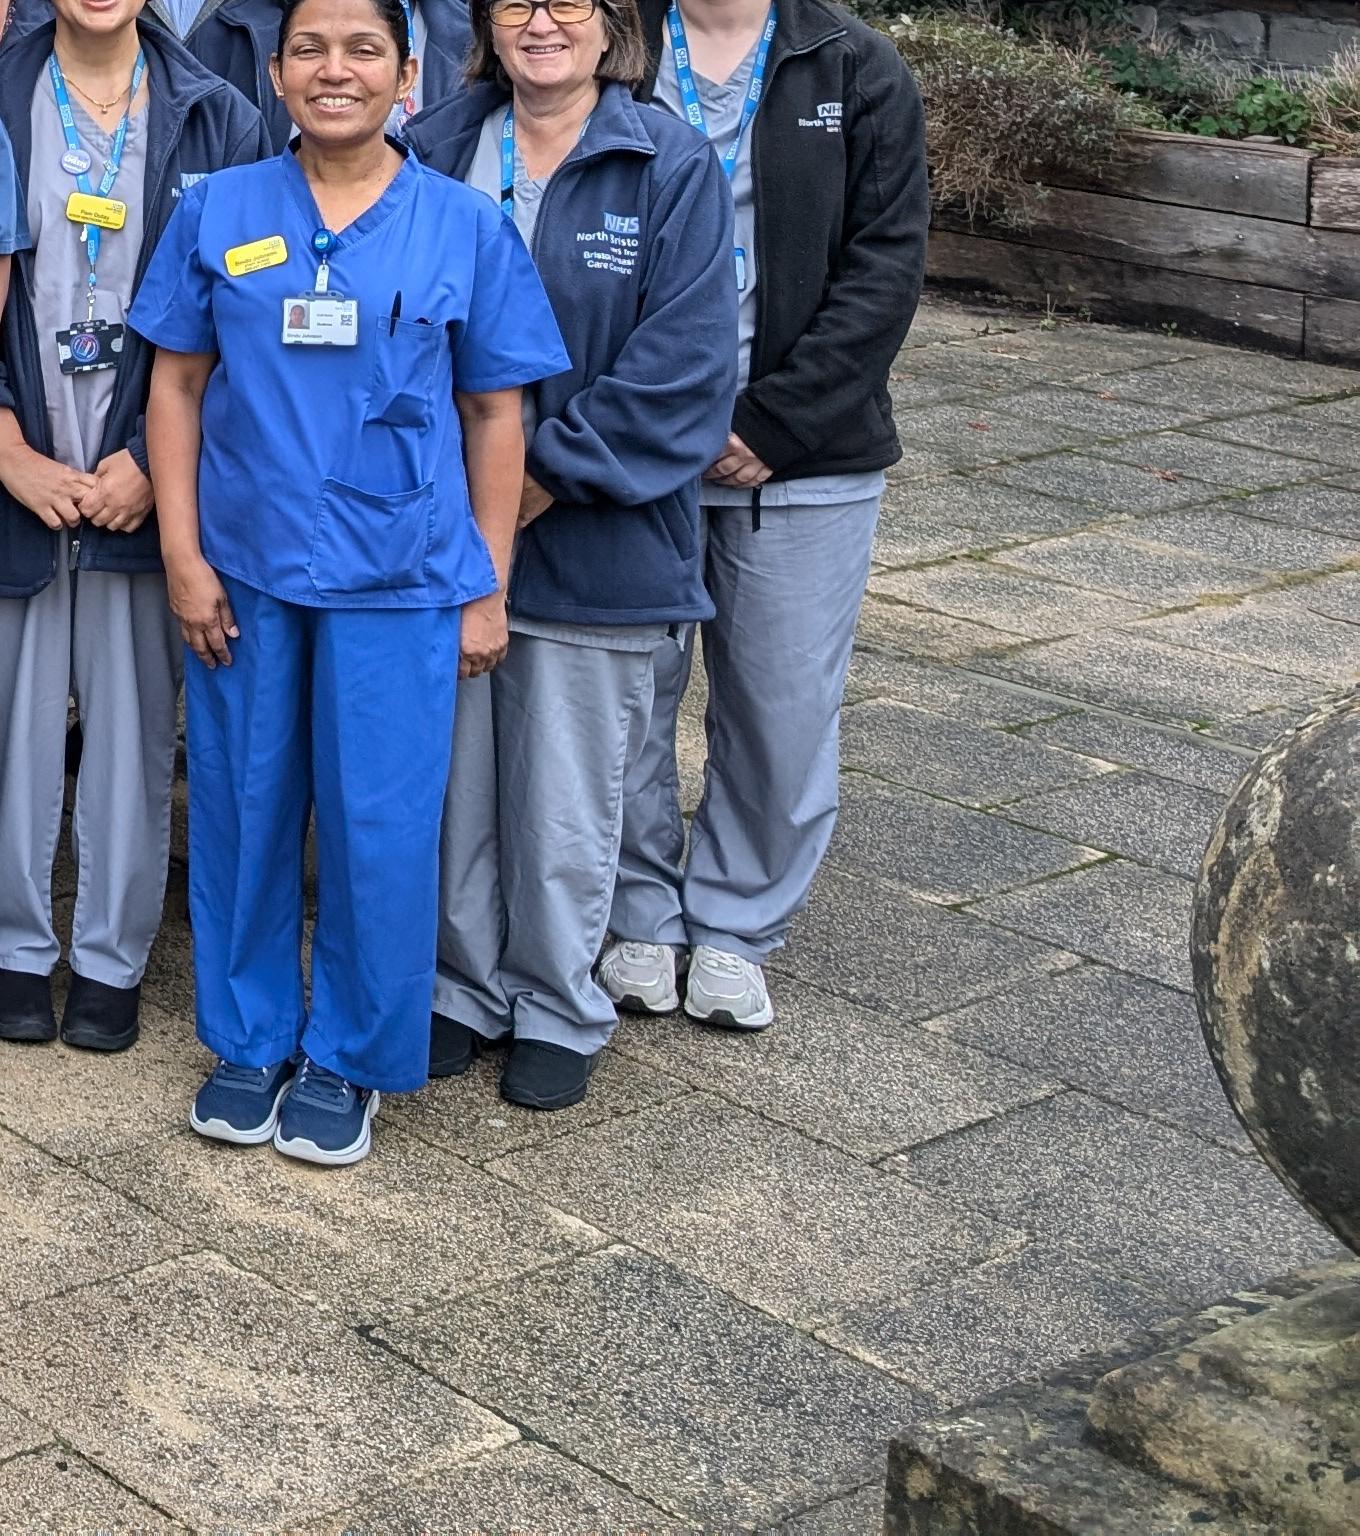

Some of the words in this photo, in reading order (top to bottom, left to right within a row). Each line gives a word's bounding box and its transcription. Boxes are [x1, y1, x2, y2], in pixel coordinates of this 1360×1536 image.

[817, 103, 842, 117] NH
[604, 212, 640, 234] NHS
[576, 231, 608, 242] North
[609, 234, 639, 247] Bristo
[586, 260, 608, 269] Care
[609, 263, 632, 275] Centre
